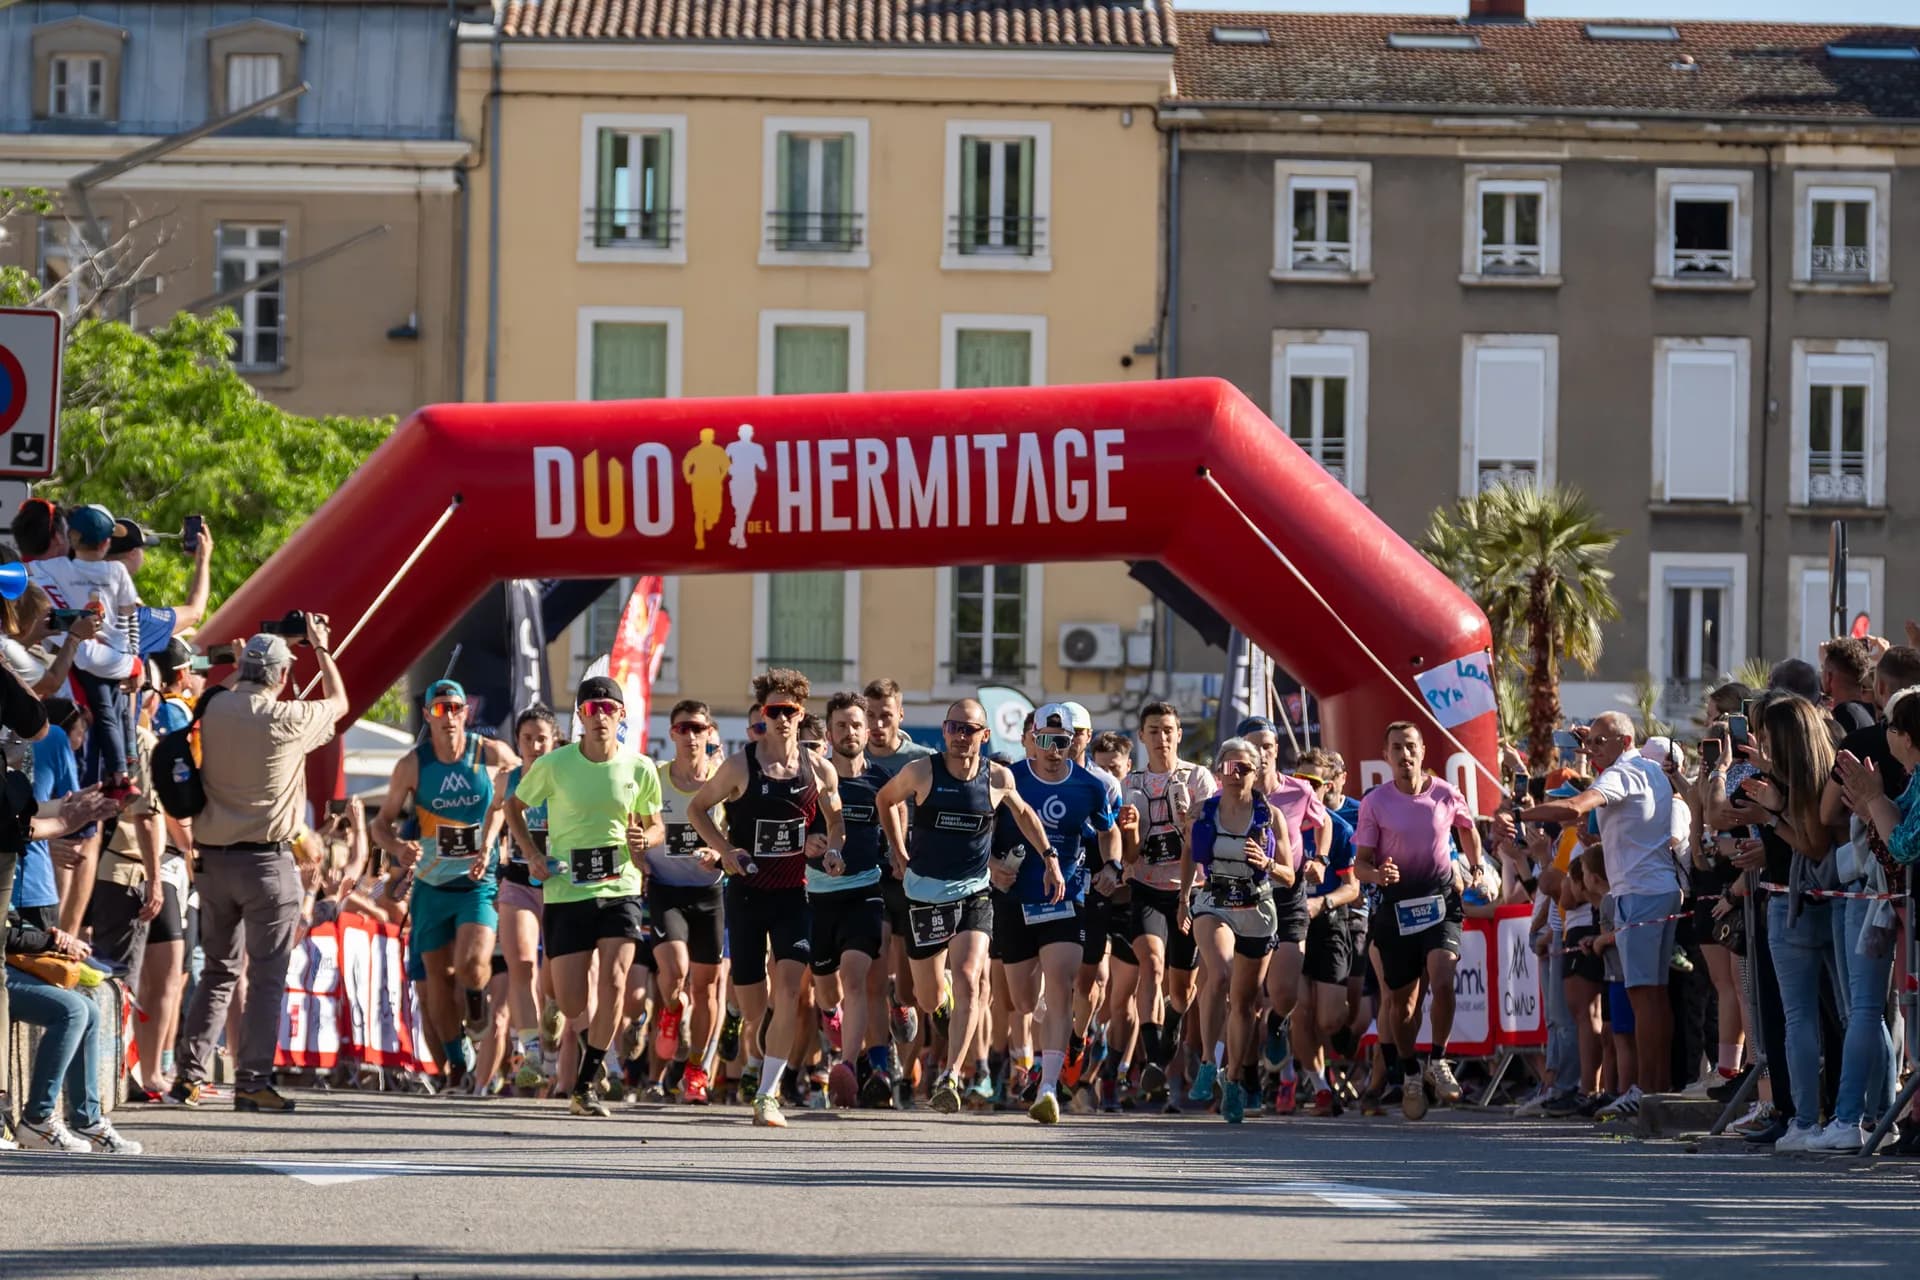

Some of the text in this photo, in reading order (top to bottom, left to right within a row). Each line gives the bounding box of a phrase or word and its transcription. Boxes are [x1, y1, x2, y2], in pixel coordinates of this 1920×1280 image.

[533, 441, 673, 540] DUO
[747, 520, 762, 534] DE
[775, 428, 1128, 533] HERMITAGE
[777, 830, 789, 841] 94
[1160, 841, 1168, 851] 2
[1411, 903, 1433, 918] 1552
[931, 914, 944, 927] 95
